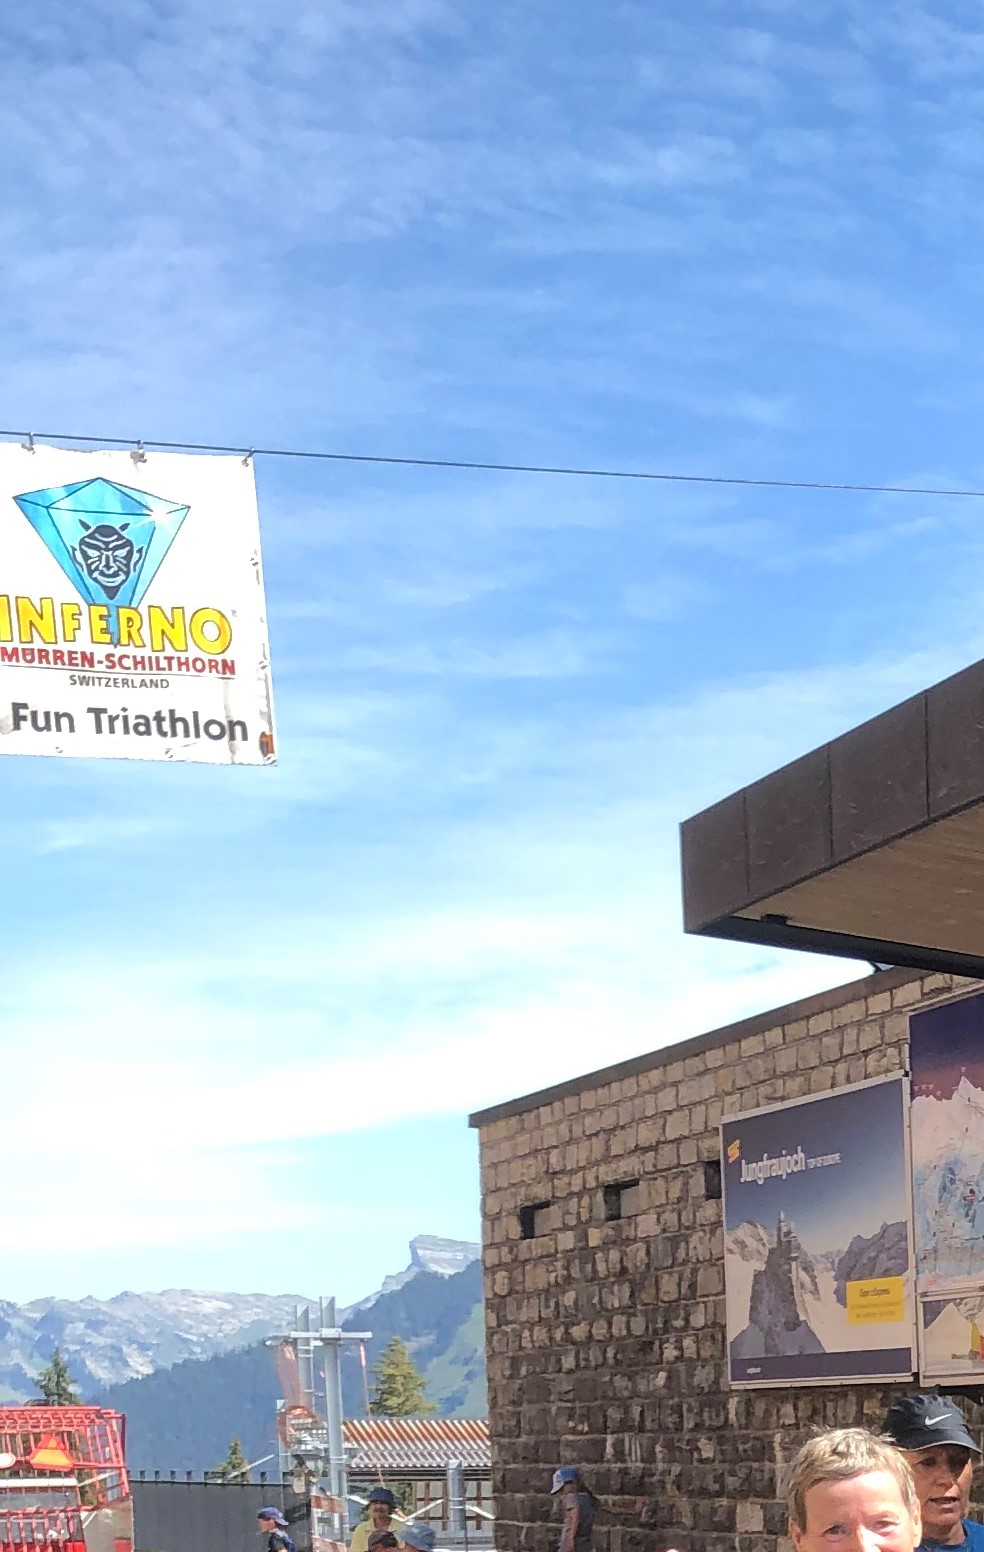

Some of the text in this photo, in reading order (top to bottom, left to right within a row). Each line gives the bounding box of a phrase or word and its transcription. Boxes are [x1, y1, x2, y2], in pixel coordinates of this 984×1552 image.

[0, 594, 232, 655] INFERNO
[0, 646, 236, 676] MÜRREN-SCHILTHORN
[69, 674, 170, 689] SWITZERLAND
[11, 702, 249, 742] Fun Triathlon
[740, 1145, 806, 1185] Jungfraujoch
